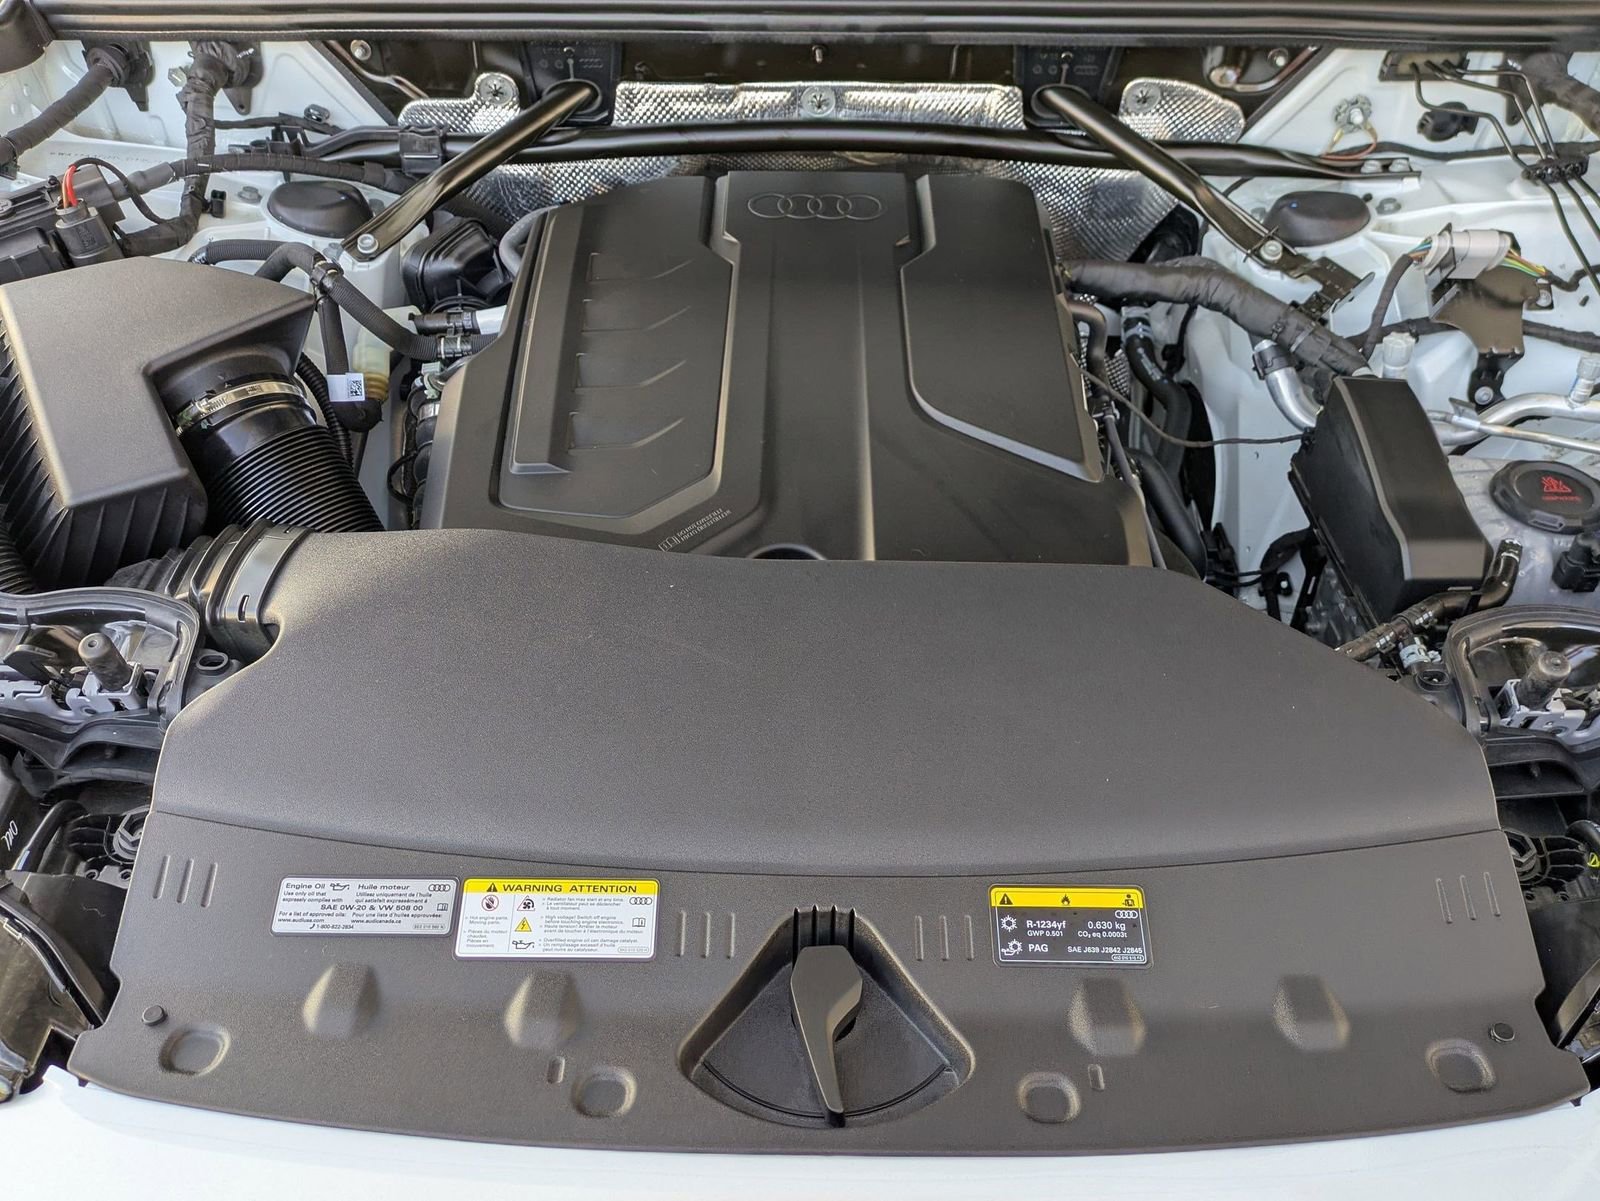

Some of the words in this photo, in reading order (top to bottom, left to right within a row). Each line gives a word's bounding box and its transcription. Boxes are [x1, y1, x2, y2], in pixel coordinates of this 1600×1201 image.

[286, 882, 312, 891] Engine
[503, 884, 563, 892] WARNING
[570, 884, 637, 893] ATTENTION
[1026, 920, 1066, 929] R-1234yf
[1087, 921, 1113, 929] 0.630
[1115, 921, 1126, 931] kg
[1028, 944, 1048, 952] PAG
[1083, 946, 1100, 954] J639
